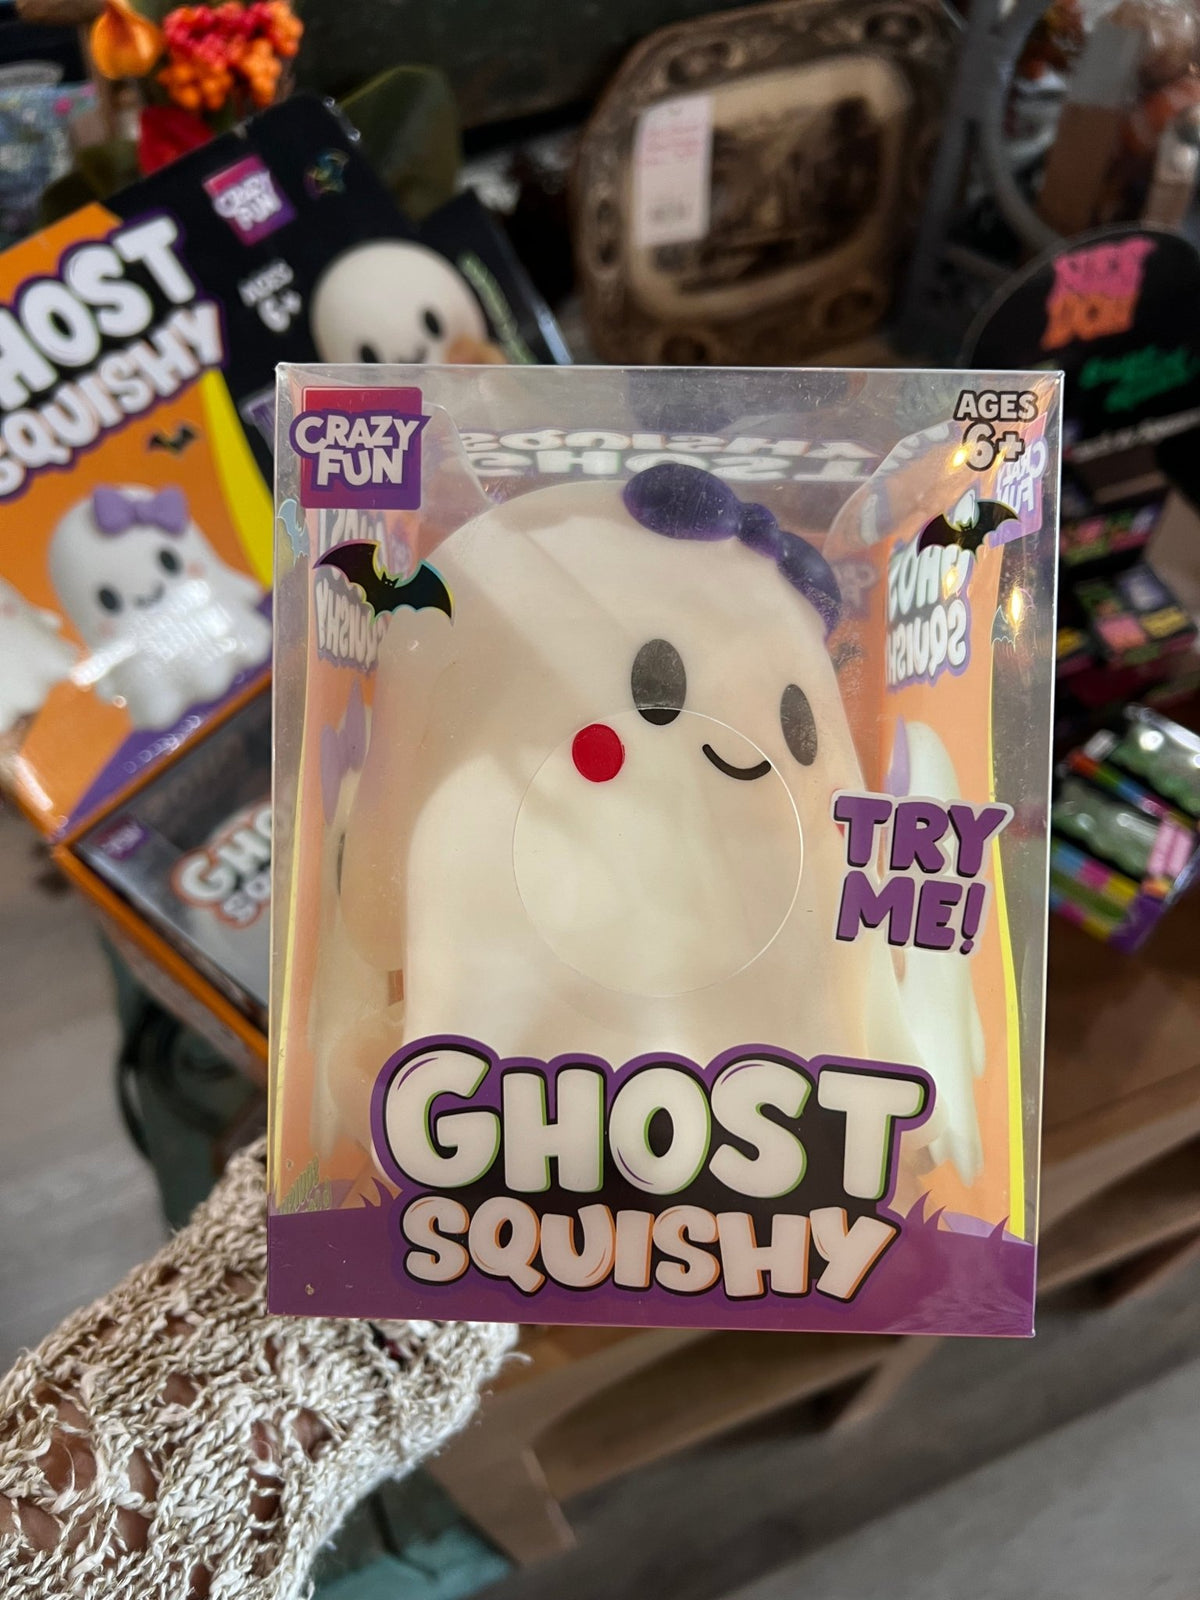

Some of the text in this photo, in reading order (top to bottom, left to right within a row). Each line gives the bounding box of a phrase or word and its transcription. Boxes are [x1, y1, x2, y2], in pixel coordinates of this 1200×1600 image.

[295, 414, 420, 454] CRAZY
[954, 391, 1037, 420] AGES
[317, 448, 403, 486] FUN
[963, 421, 1025, 471] 6+
[834, 796, 1007, 878] TRY
[836, 870, 986, 955] ME!
[385, 1049, 926, 1199] GHOST
[402, 1196, 898, 1299] SQUISHY
